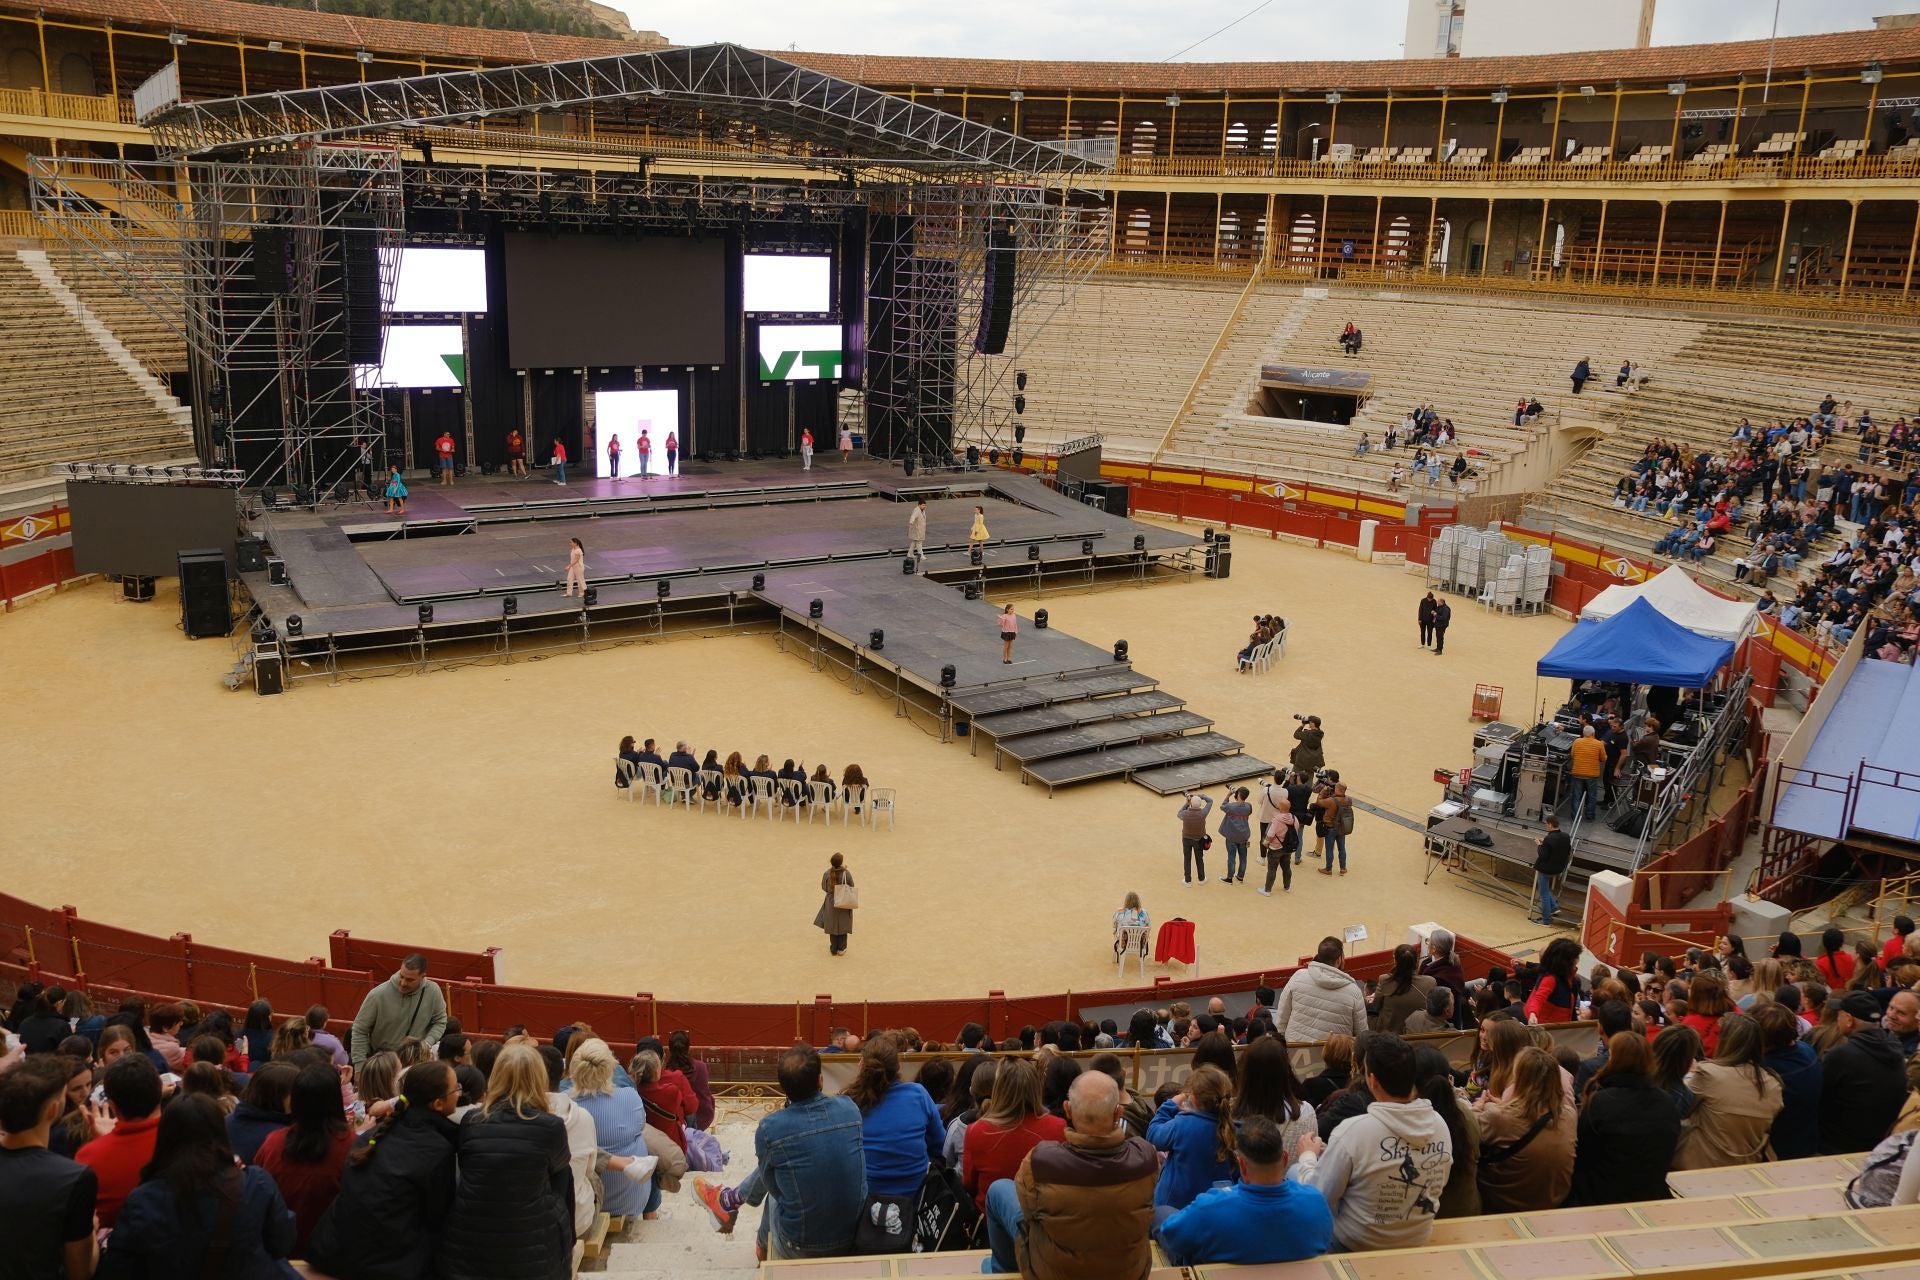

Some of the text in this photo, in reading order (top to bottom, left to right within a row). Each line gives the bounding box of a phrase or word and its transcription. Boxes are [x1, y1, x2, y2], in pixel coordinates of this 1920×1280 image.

[26, 522, 31, 534] 7
[1619, 565, 1625, 575] 2
[1609, 933, 1616, 954] 2
